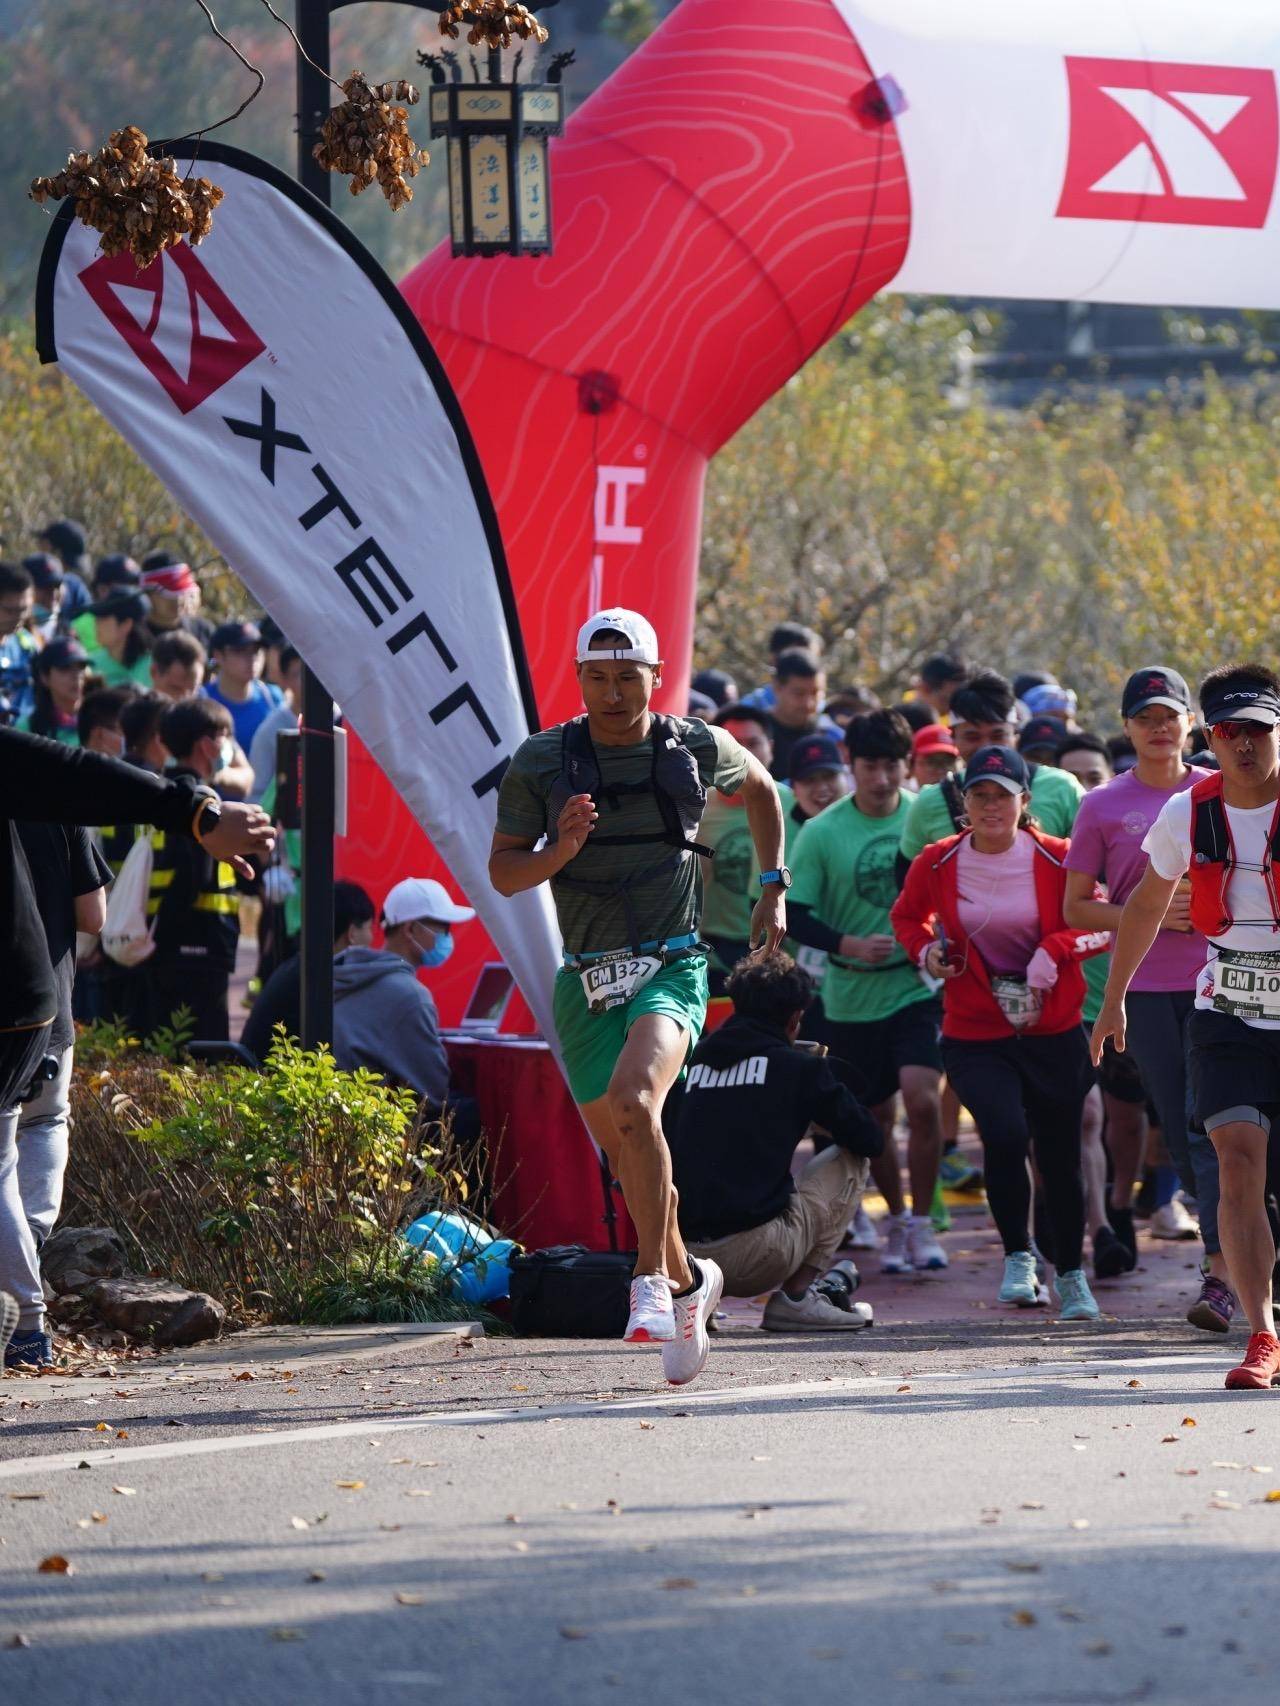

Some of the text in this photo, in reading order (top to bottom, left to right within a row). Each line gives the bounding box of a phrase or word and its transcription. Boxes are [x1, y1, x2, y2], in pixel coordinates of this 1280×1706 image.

[591, 961, 652, 988] CM 327
[1227, 970, 1250, 990] CM
